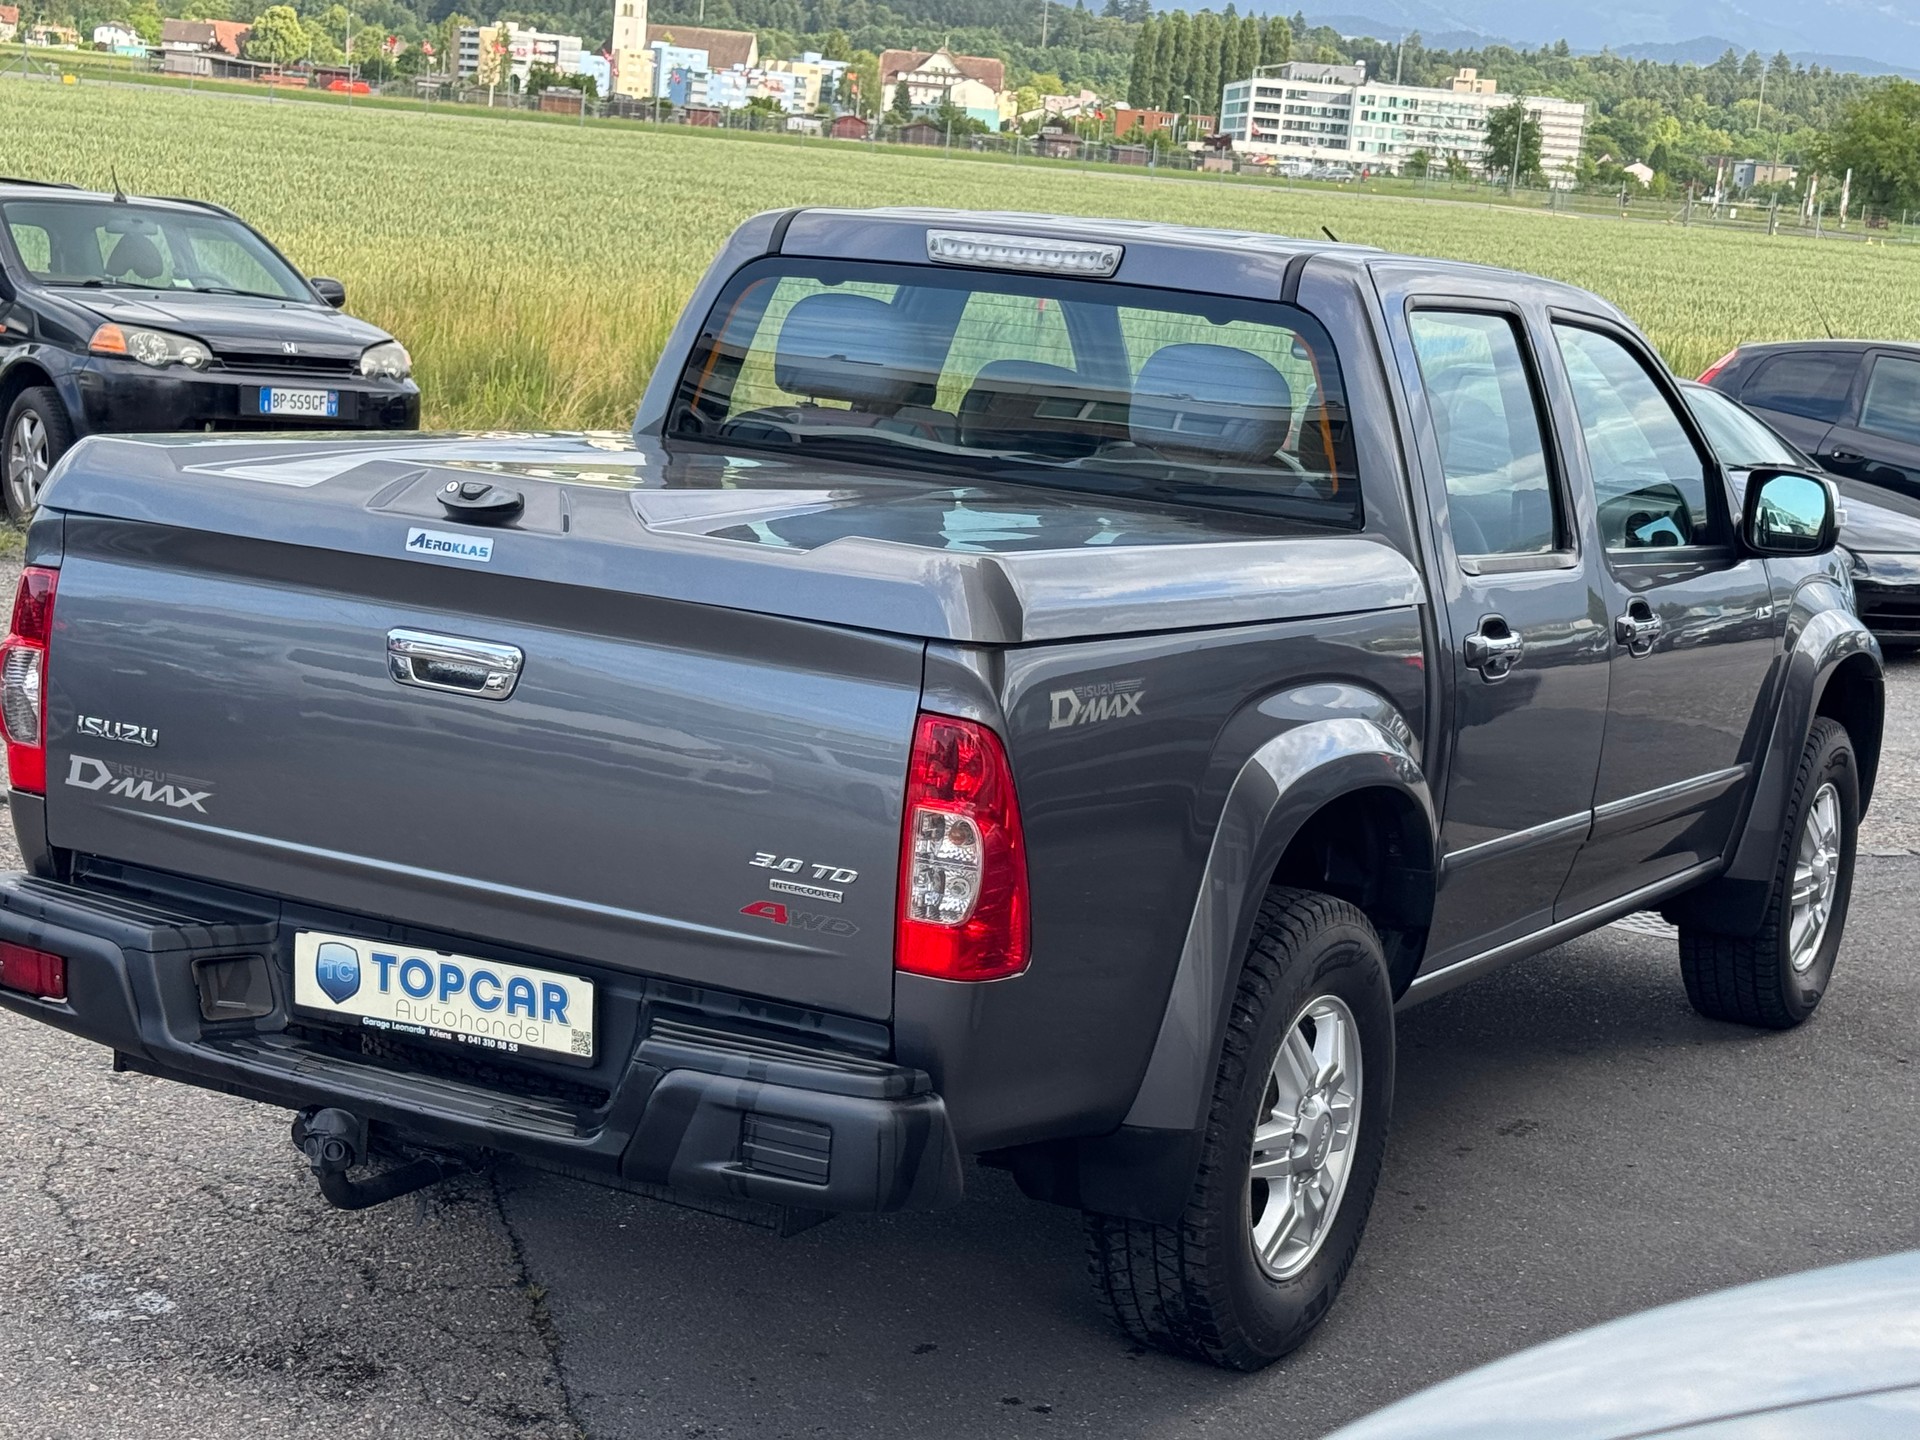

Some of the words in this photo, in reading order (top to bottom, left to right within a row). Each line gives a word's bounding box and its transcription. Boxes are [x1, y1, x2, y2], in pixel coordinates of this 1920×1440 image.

[1083, 683, 1115, 697] ISUZU
[77, 714, 159, 747] ISUZU
[117, 763, 166, 783] ISUZU
[748, 852, 804, 874] 3.0
[811, 863, 859, 884] TD
[771, 881, 841, 900] INTERCOOLER
[739, 900, 860, 937] 4WD
[322, 959, 355, 983] TC
[370, 951, 571, 1026] TOPCAR
[362, 1017, 390, 1029] Garage
[391, 1021, 426, 1035] Leonardo
[429, 1028, 452, 1040] Kriens
[395, 999, 546, 1044] Autohandel
